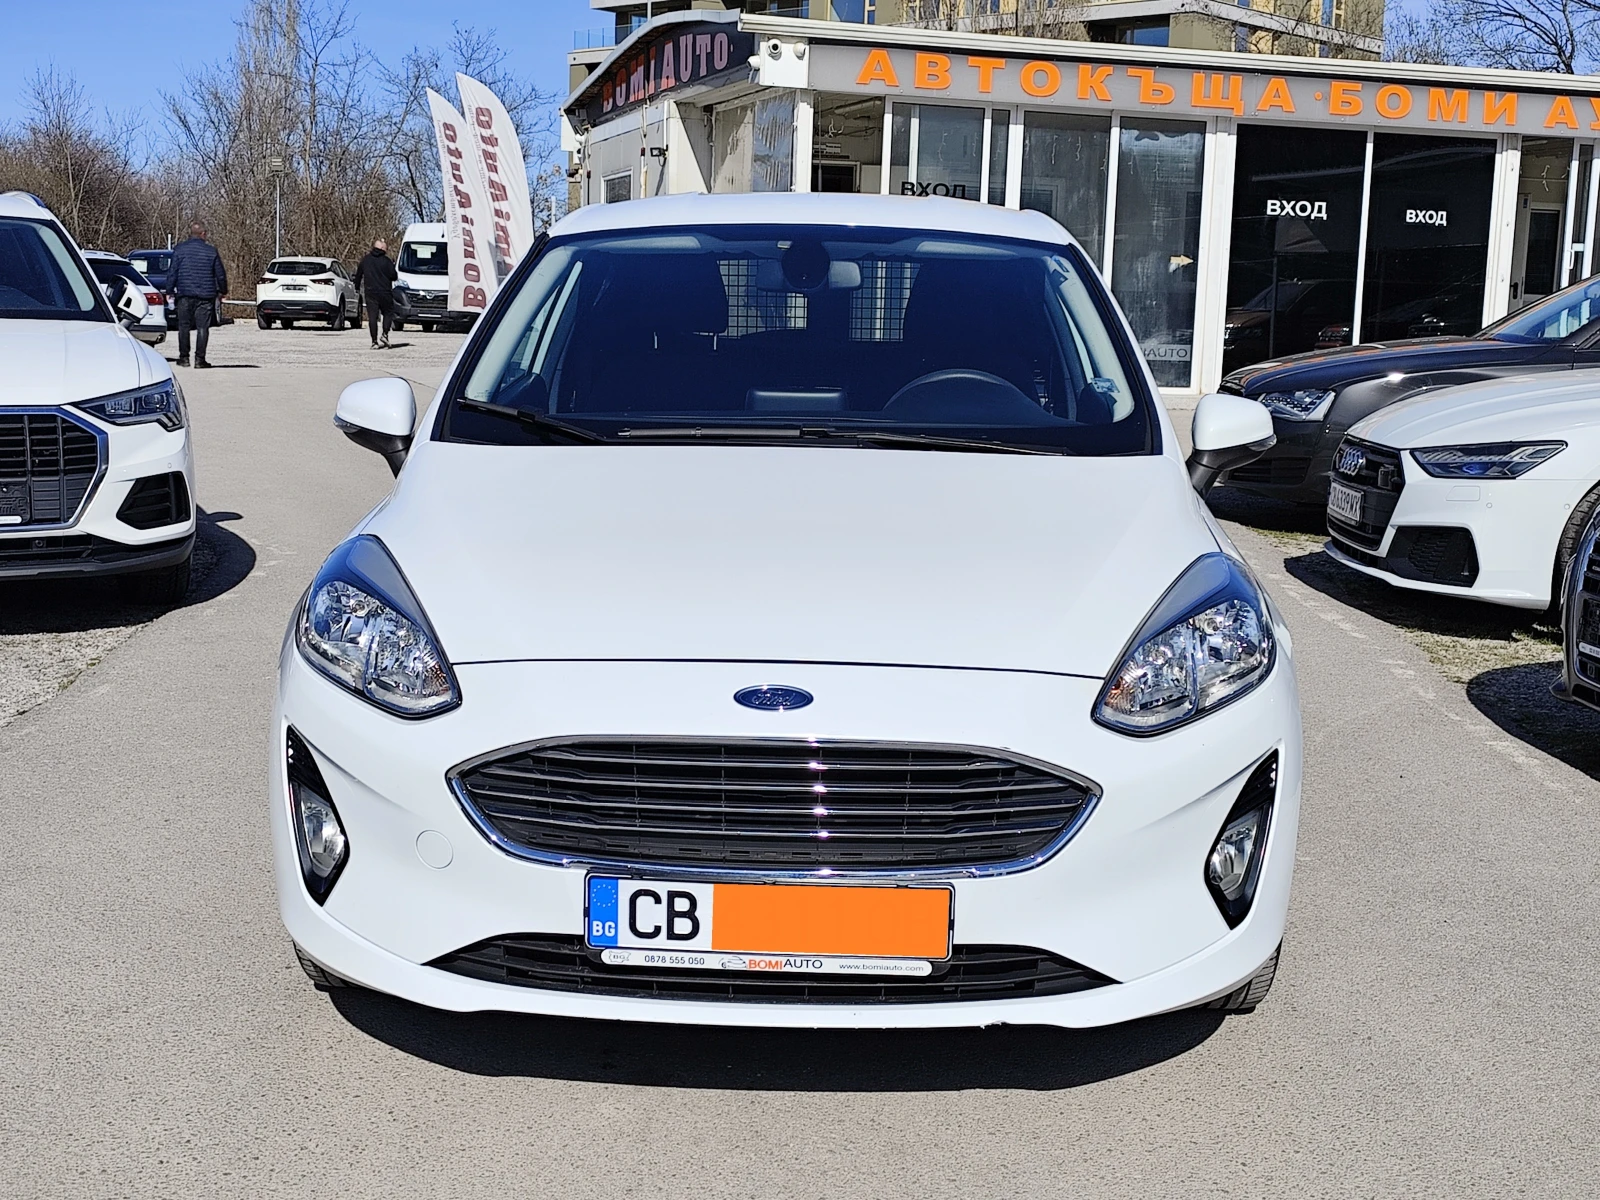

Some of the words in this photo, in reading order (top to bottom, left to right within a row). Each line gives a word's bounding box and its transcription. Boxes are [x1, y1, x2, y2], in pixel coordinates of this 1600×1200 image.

[855, 48, 1296, 117] АВТОКЪЩА
[1328, 80, 1519, 127] БОМИ
[901, 181, 967, 199] ВХОД
[1266, 199, 1328, 220] ВХОД
[1405, 209, 1448, 226] ВХОД
[752, 689, 796, 705] Ford
[628, 888, 700, 941] CB
[592, 920, 616, 937] BG
[644, 954, 667, 963] 0878
[669, 955, 686, 964] 555
[688, 956, 705, 965] 050
[838, 962, 925, 972] www.bomiauto.com
